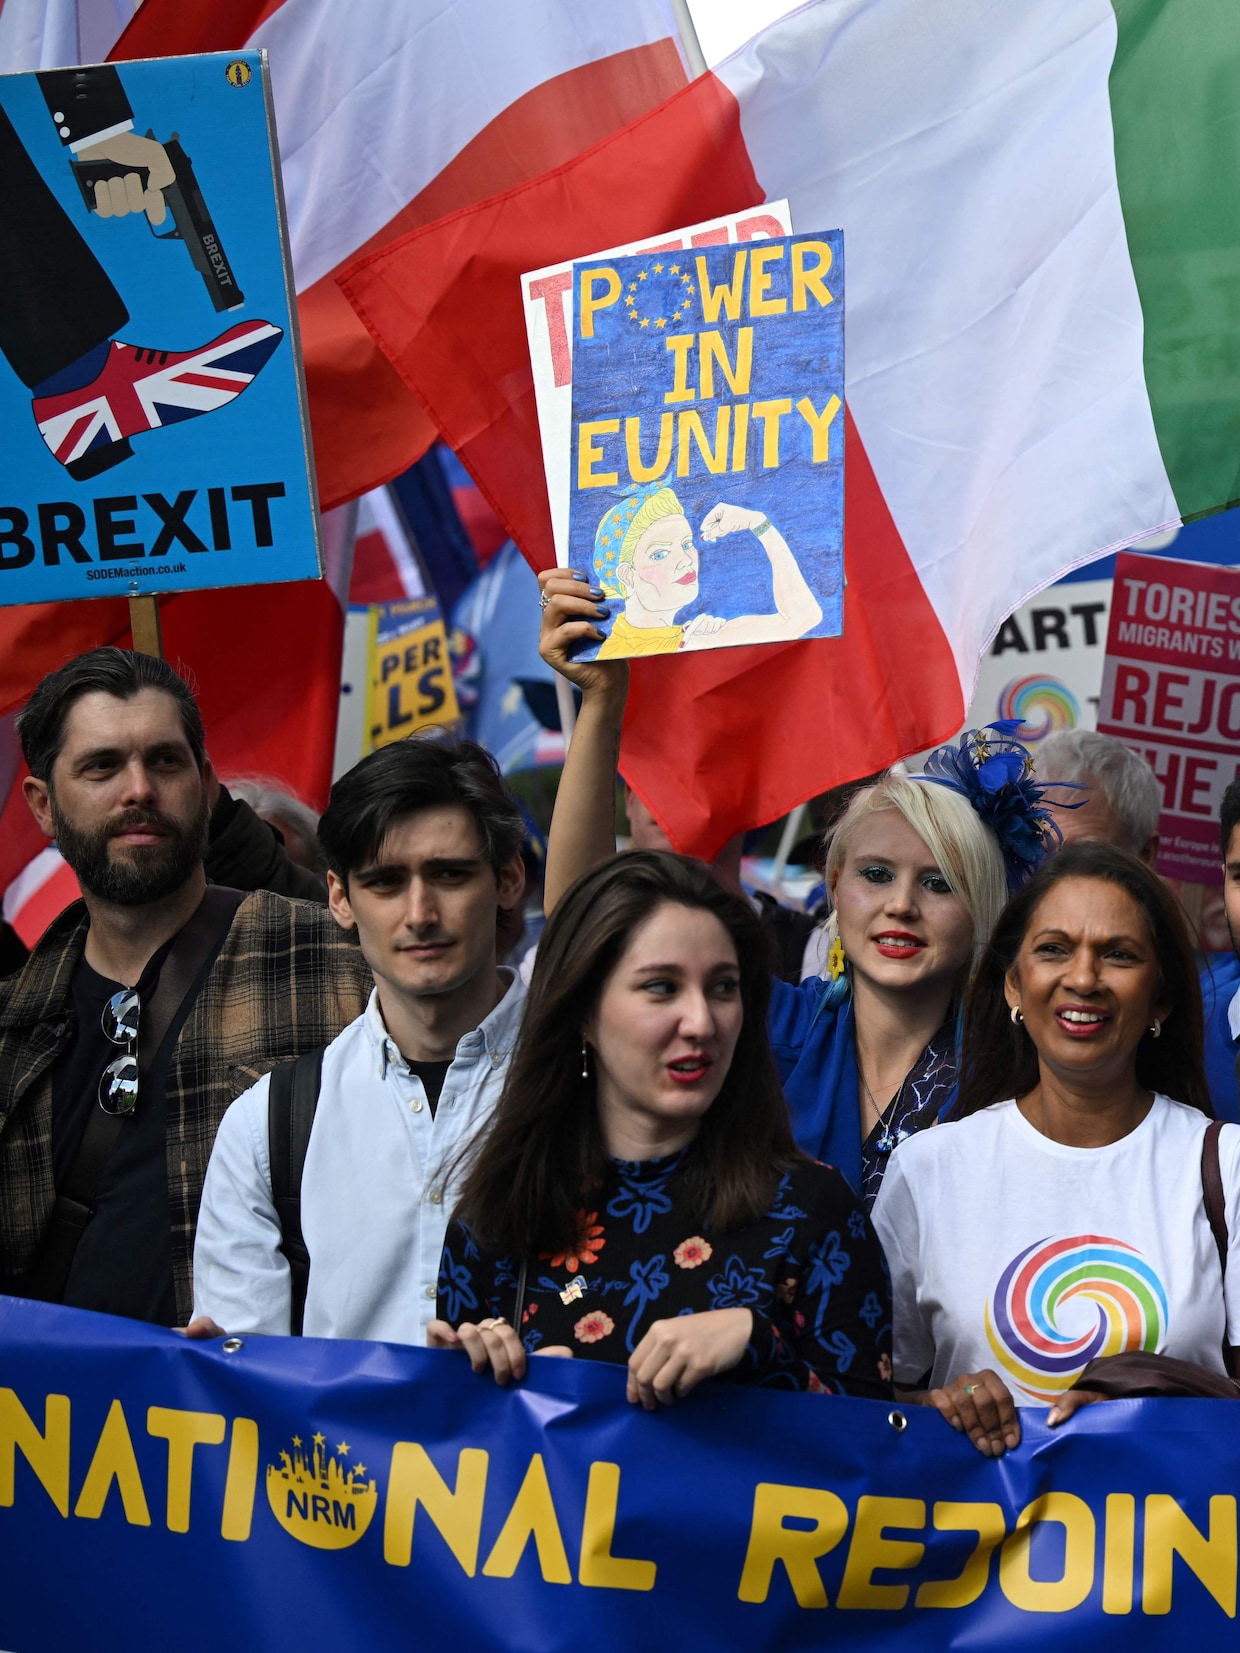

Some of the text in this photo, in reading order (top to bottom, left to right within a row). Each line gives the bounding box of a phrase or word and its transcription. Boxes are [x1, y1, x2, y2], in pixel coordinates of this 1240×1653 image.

[203, 234, 232, 285] BREXIT
[664, 327, 753, 404] IN
[577, 394, 841, 489] EUNITY
[0, 482, 286, 570] BREXIT
[86, 562, 187, 581] SODEMaction.co.uk
[1118, 621, 1223, 659] MIGRANTS
[1131, 746, 1219, 816] HE
[286, 1489, 356, 1532] NRM
[738, 1482, 1238, 1618] REJOIN
